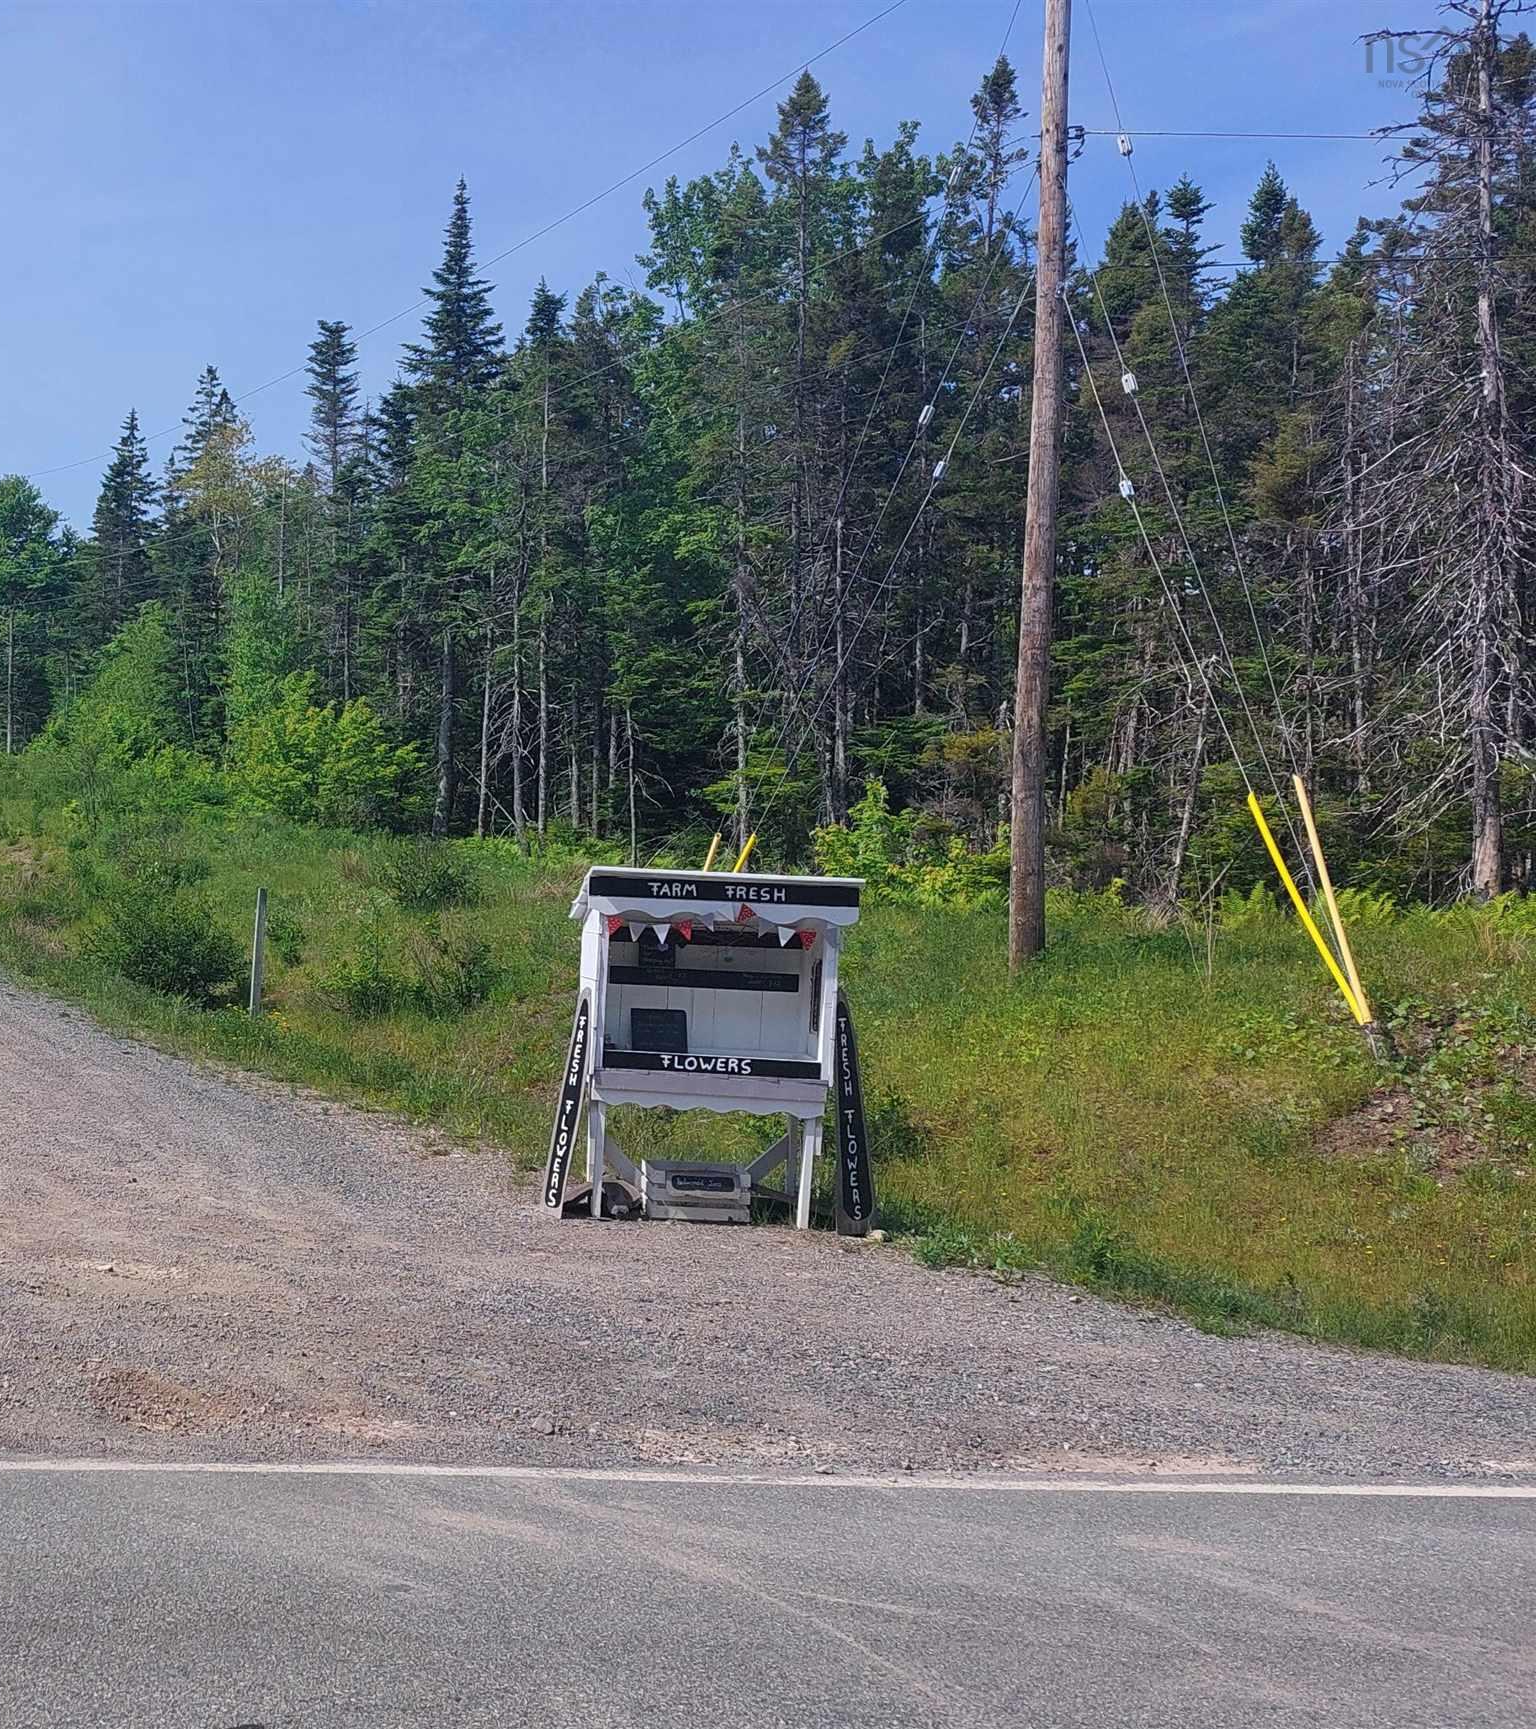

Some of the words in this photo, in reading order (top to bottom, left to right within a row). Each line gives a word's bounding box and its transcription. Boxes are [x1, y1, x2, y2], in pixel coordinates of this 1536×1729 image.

[647, 882, 697, 897] FARM
[724, 885, 786, 902] FRESH
[568, 1016, 587, 1087] FRESH
[660, 1054, 752, 1075] FLOWERS
[838, 1017, 853, 1097] FRESH
[547, 1100, 574, 1208] FLOWERS
[844, 1109, 863, 1221] FLOWERS
